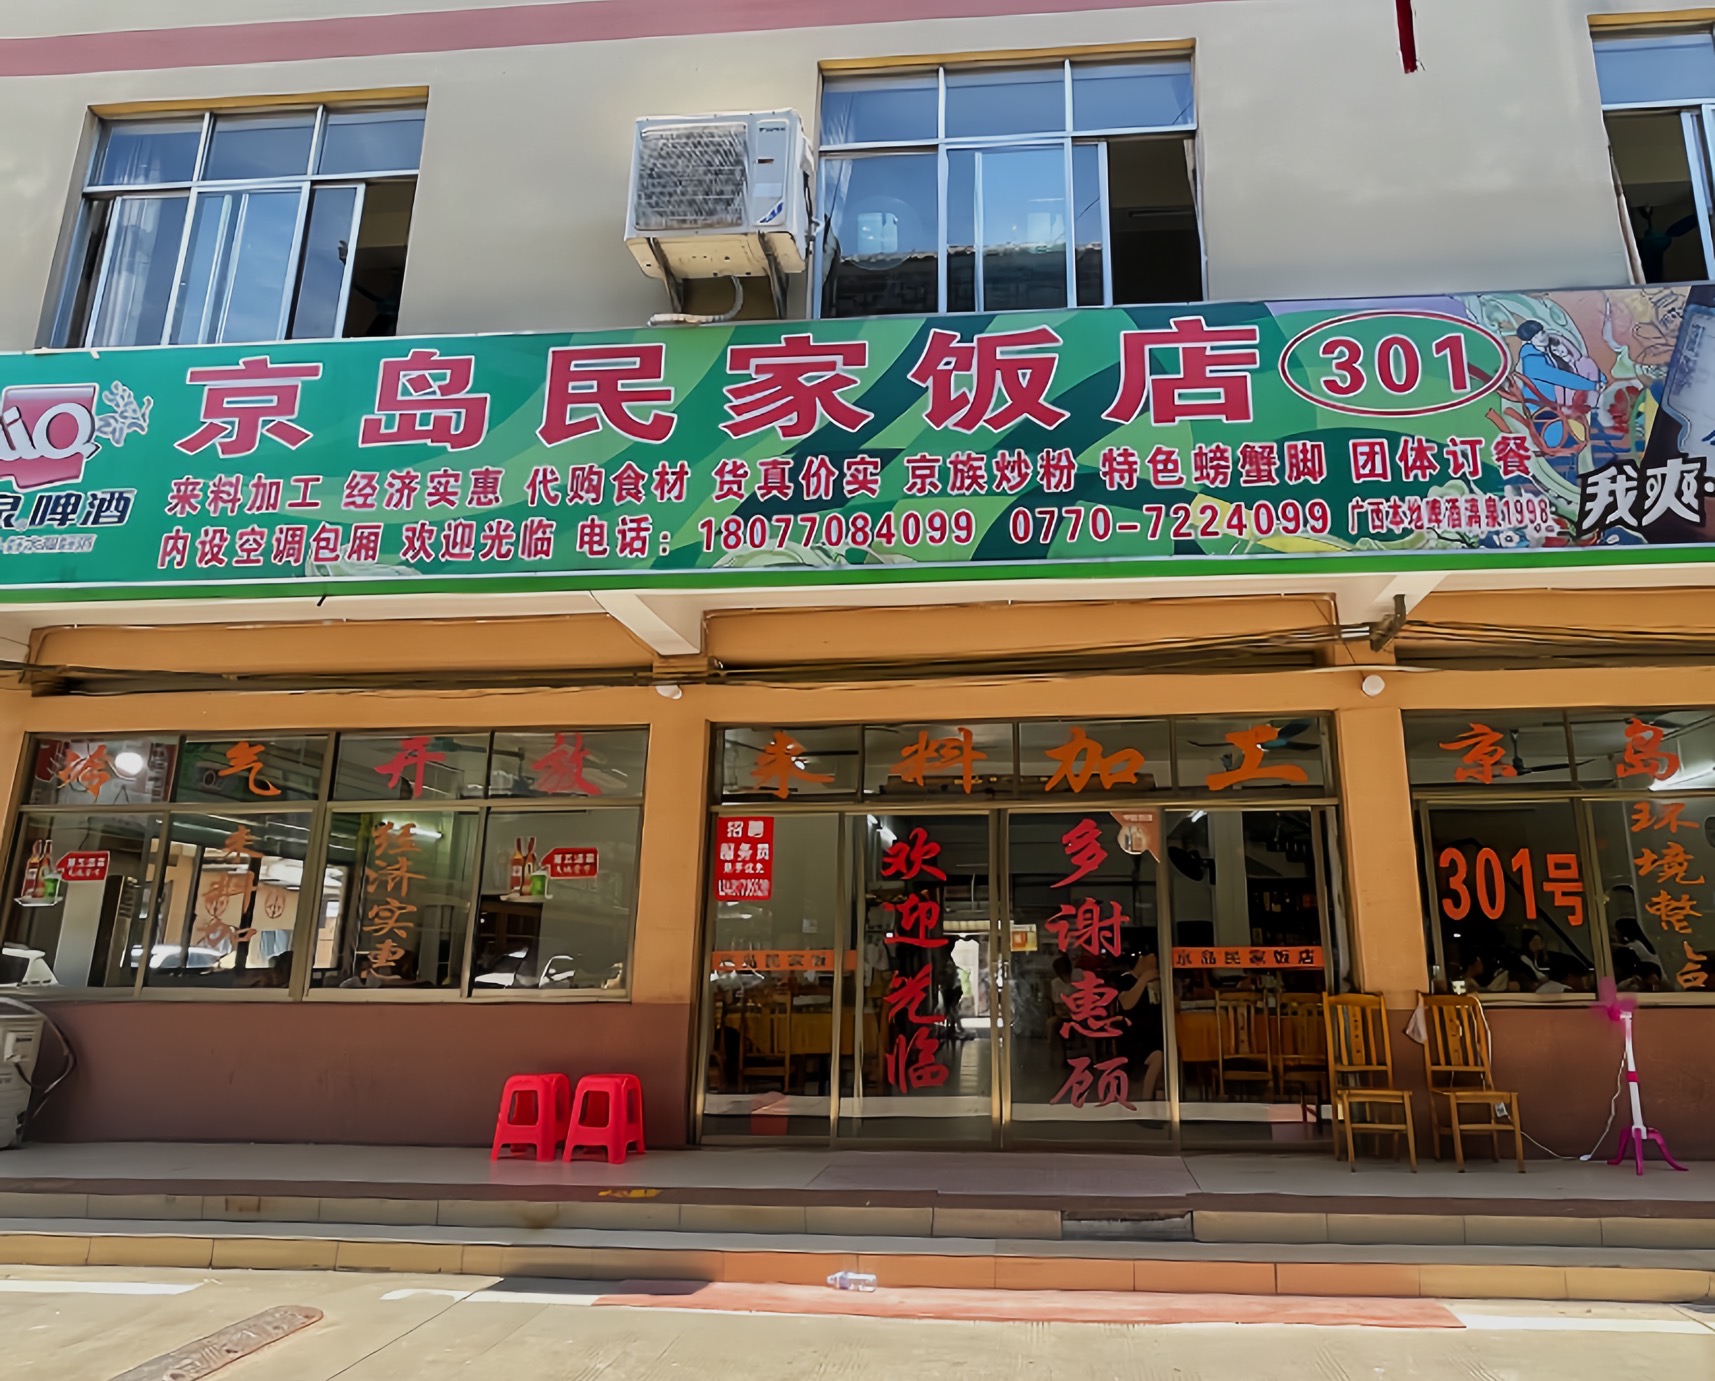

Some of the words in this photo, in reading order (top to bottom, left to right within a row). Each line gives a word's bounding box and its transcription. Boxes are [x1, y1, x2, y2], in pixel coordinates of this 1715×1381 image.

[173, 315, 1259, 459] 京岛民家饭店
[1319, 332, 1472, 397] 301
[165, 474, 324, 518] 来料加工
[342, 467, 506, 511] 经济实惠
[524, 460, 690, 506] 代购食材
[712, 454, 883, 503] 货真价实
[903, 448, 1078, 497] 京族炒粉
[1099, 441, 1328, 491] 特色螃蟹脚
[1348, 434, 1535, 483] 团体订餐
[1580, 457, 1701, 530] 我爽
[157, 521, 384, 570] 内设空调包厢
[400, 517, 558, 563] 欢迎光临
[698, 508, 976, 554] 18077084099
[1008, 499, 1332, 544] 0770-7224099
[752, 724, 1309, 799] 来料加工
[1439, 717, 1682, 784] 京岛
[1438, 846, 1586, 926] 301号
[881, 827, 949, 1095] 欢迎光临
[1043, 818, 1138, 1112] 多谢惠顾
